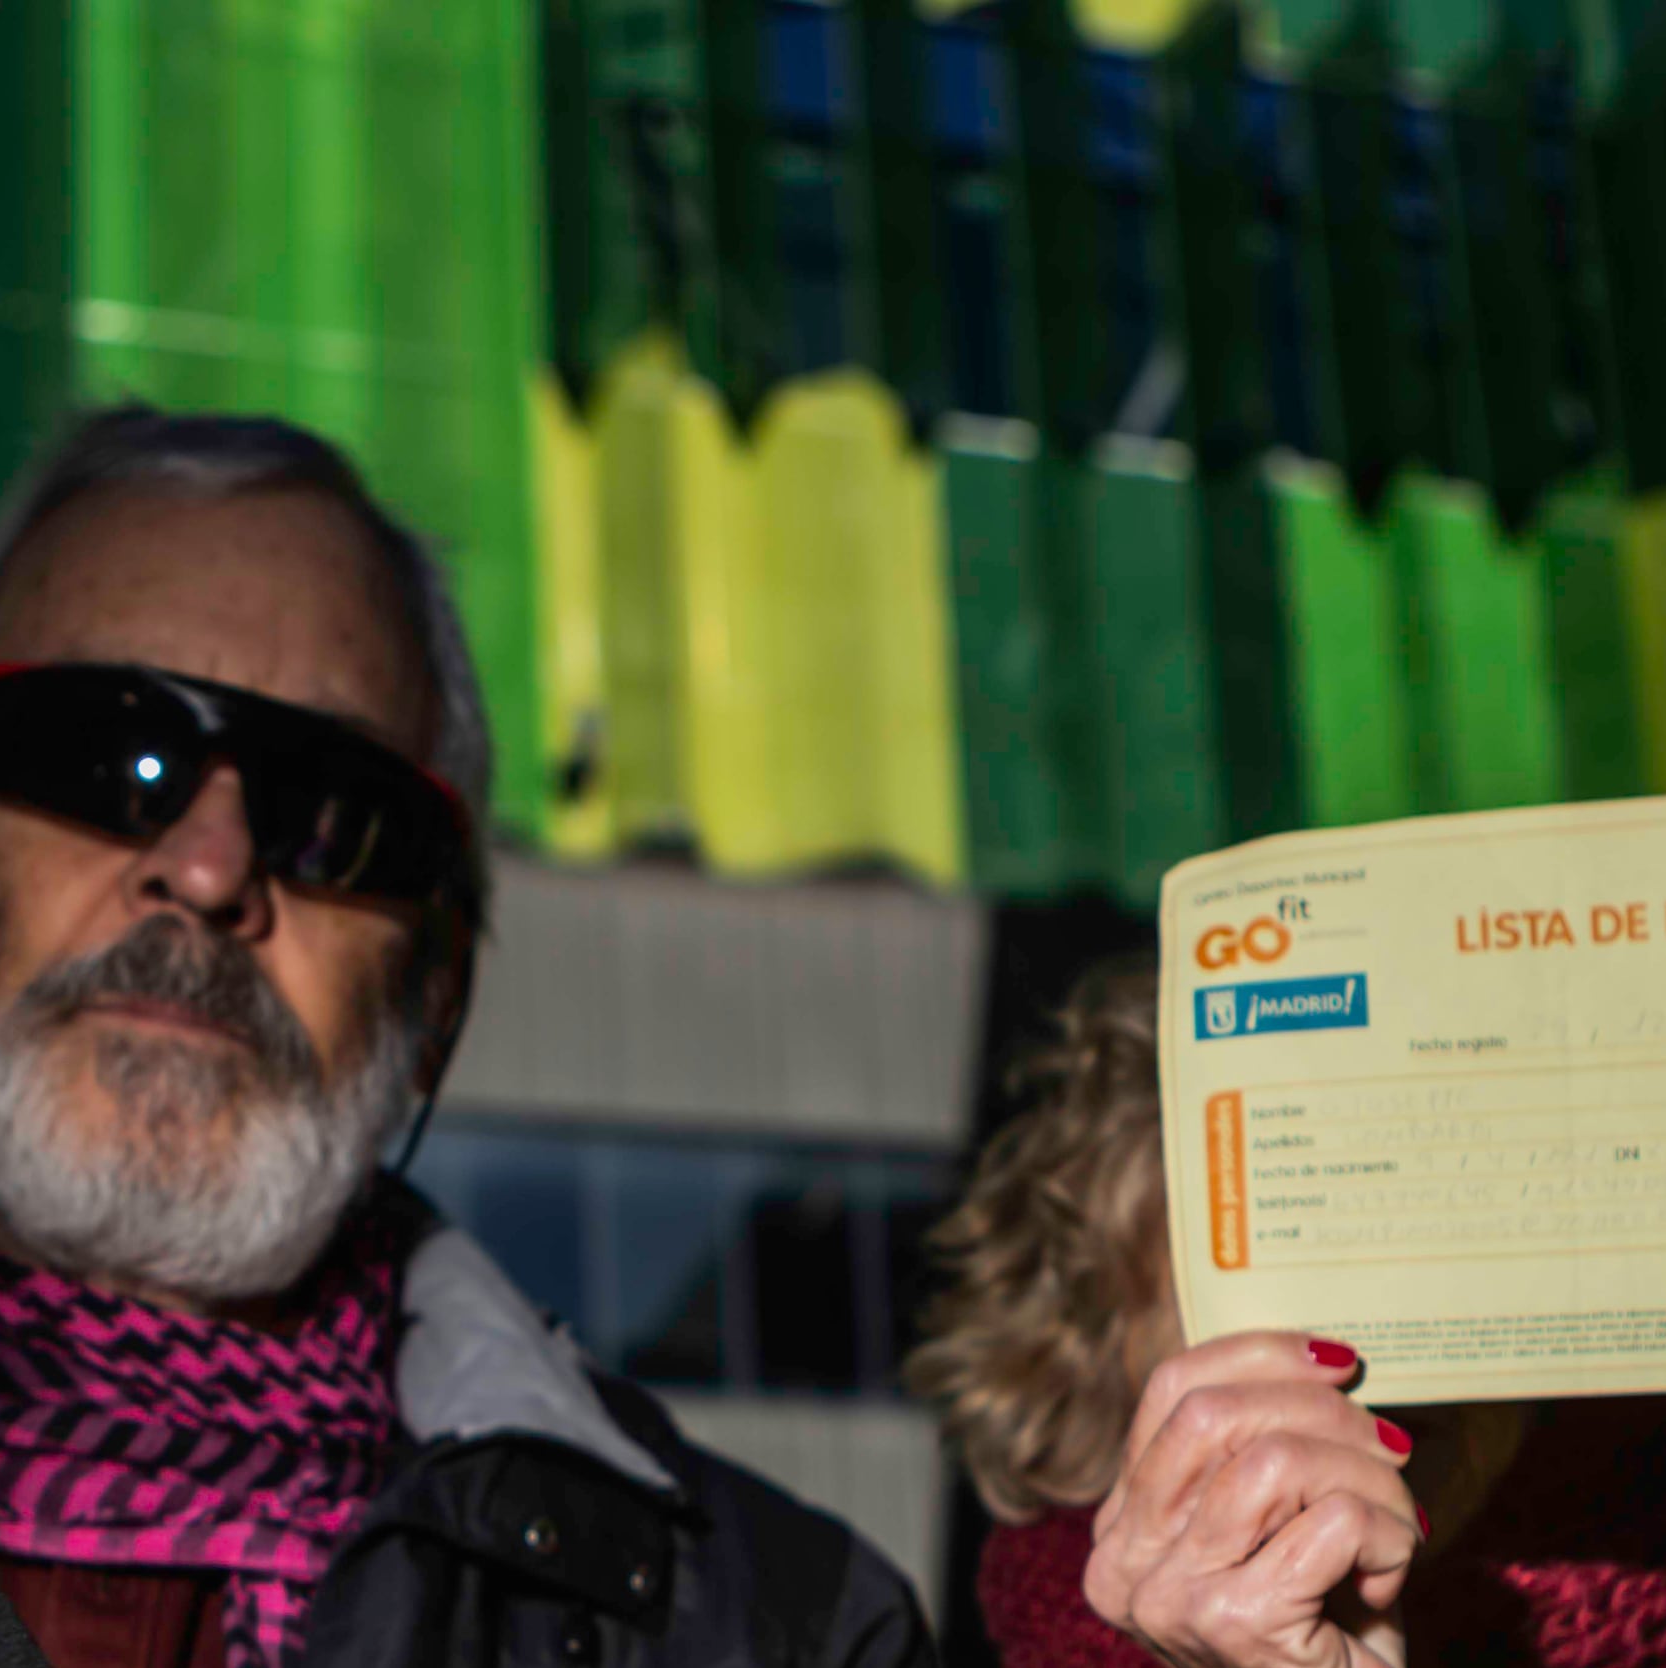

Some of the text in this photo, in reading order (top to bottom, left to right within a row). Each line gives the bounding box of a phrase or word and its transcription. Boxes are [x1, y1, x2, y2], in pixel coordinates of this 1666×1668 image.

[1277, 895, 1311, 921] fit
[1590, 902, 1650, 945] DE
[1194, 914, 1292, 971] GO
